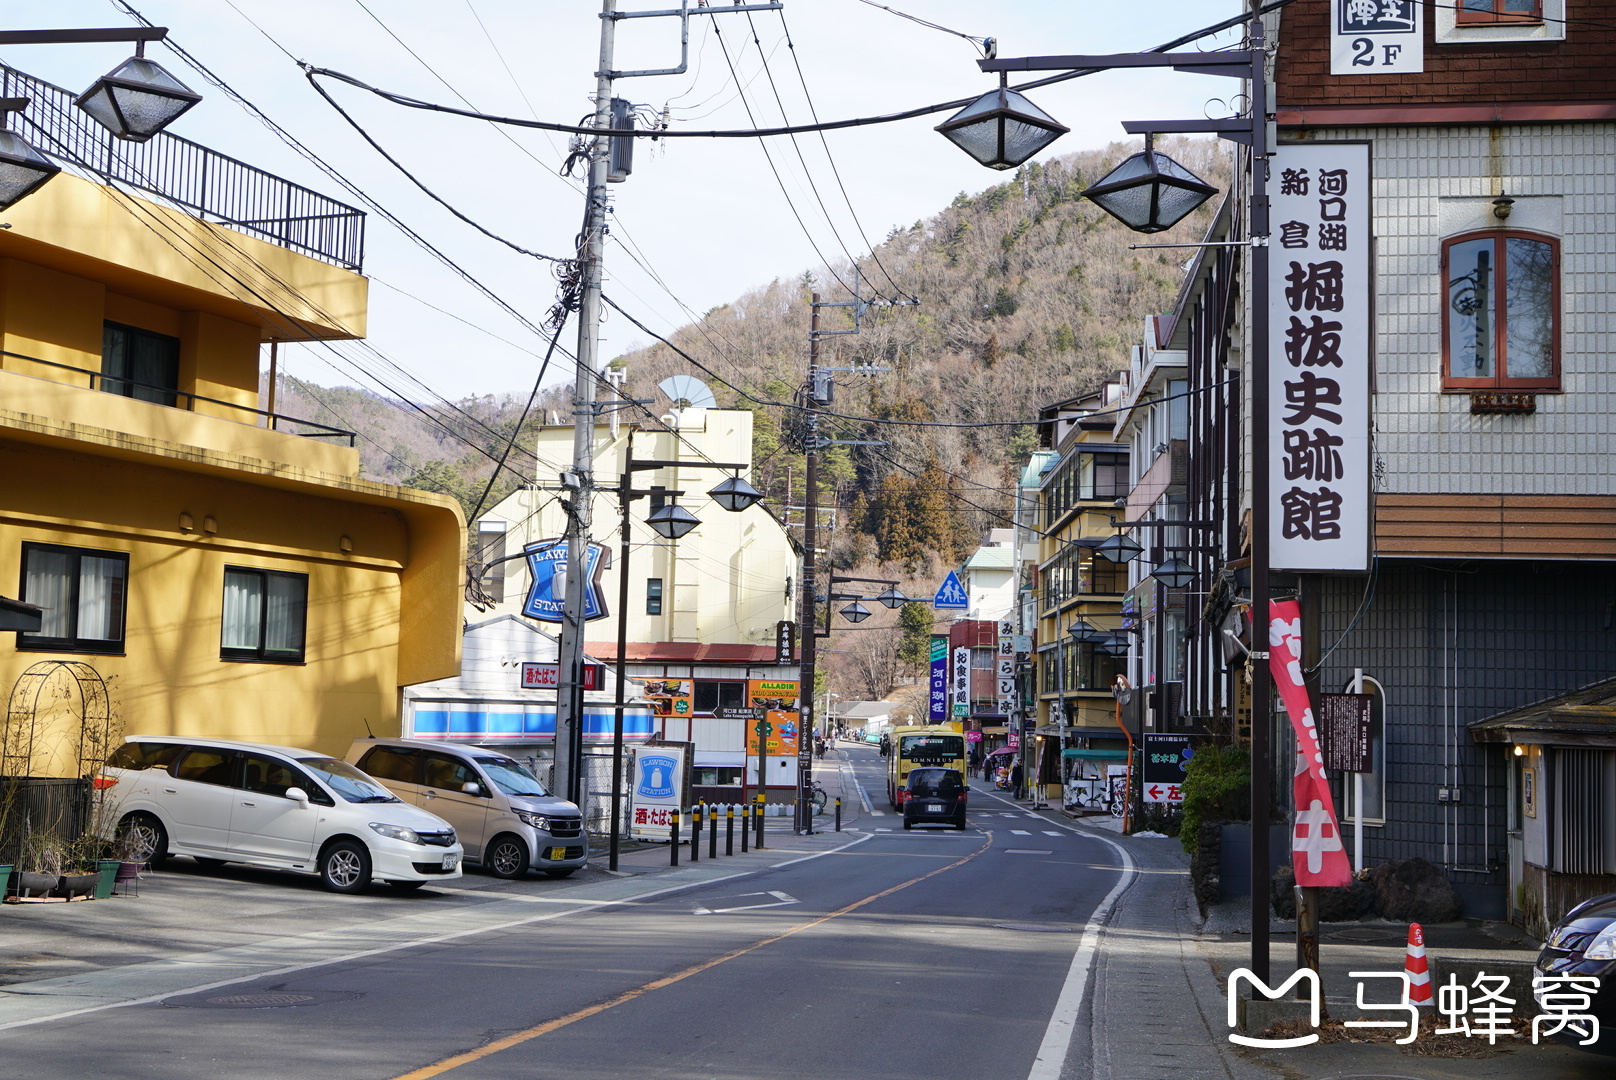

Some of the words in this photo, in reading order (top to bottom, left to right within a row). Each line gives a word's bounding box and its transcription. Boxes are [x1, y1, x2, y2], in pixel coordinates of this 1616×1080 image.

[1318, 168, 1348, 252] 河口湖
[1281, 260, 1344, 542] 掘抜史跡館
[535, 549, 593, 562] LAW
[533, 598, 591, 612] STATN
[1000, 622, 1013, 713] みはらし亭
[956, 652, 967, 703] お食事処
[761, 682, 795, 690] ALLADIN
[643, 759, 674, 768] LAWSON
[641, 786, 671, 795] STATION
